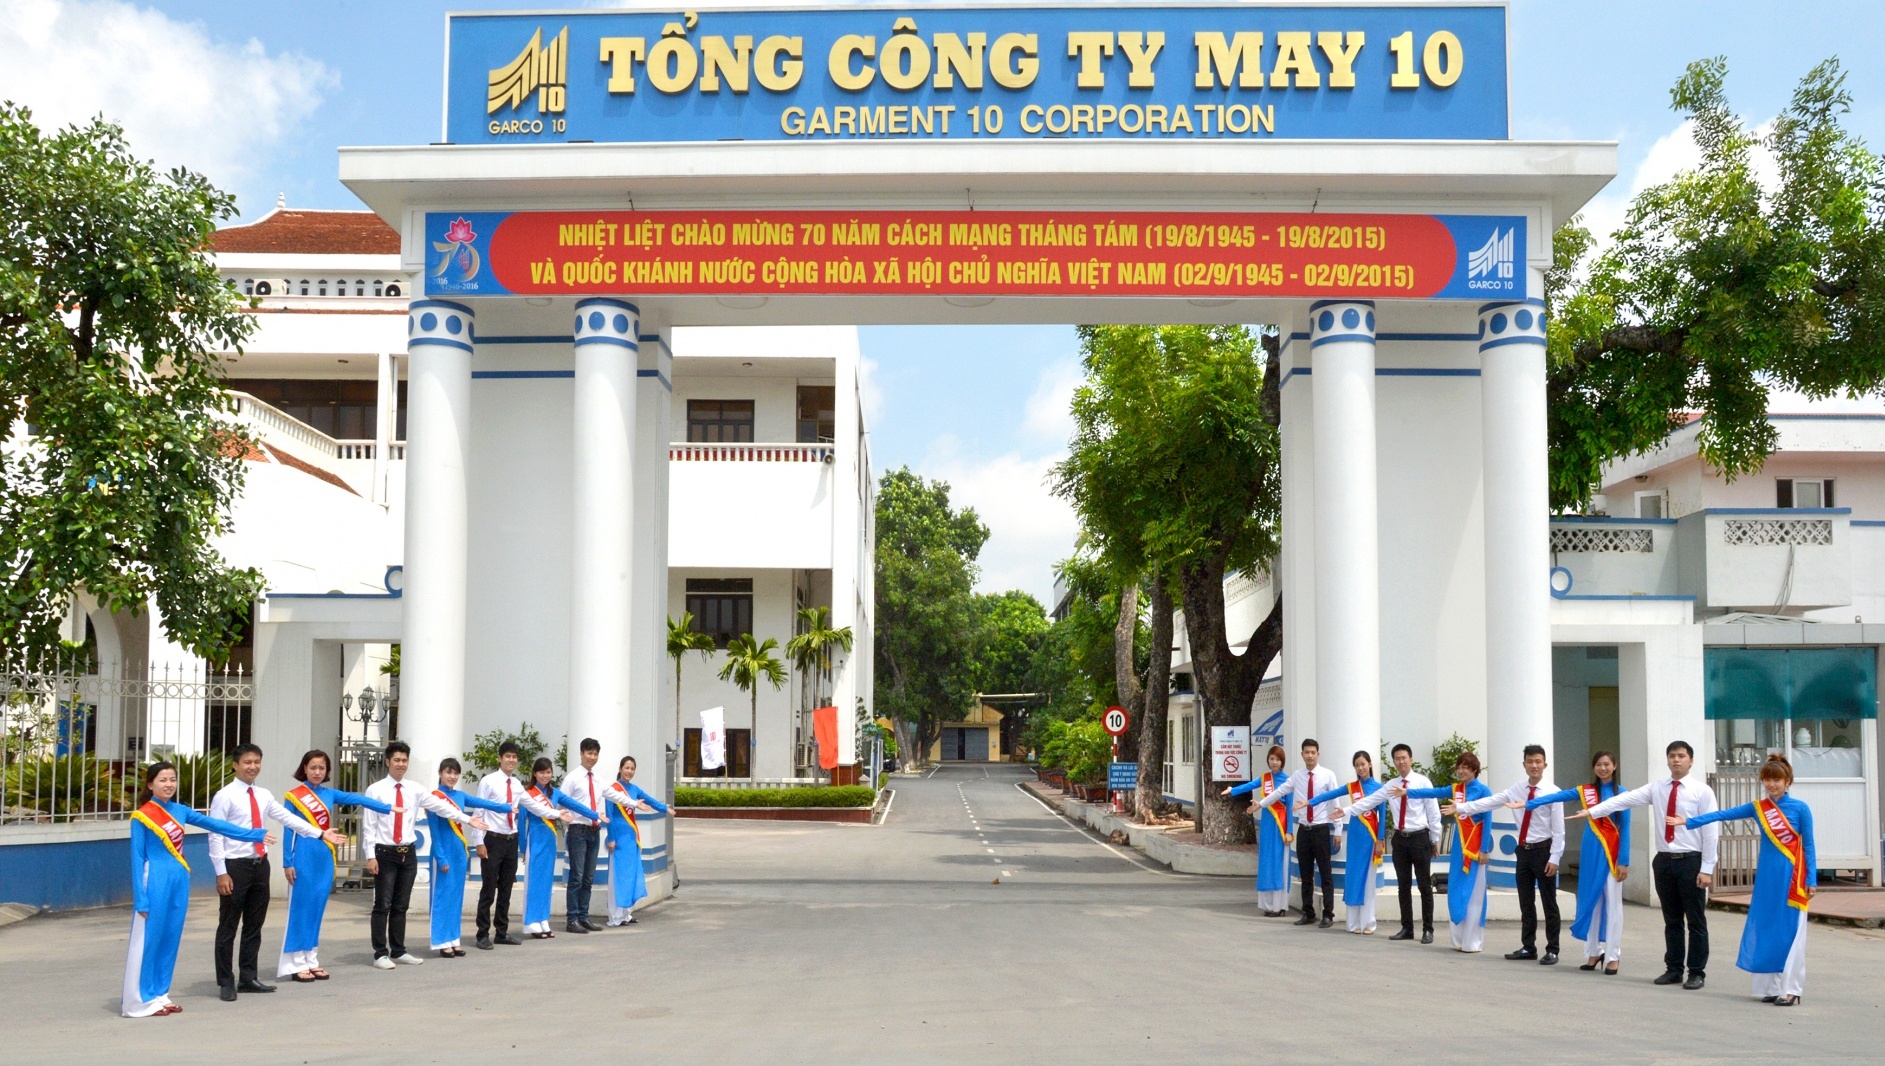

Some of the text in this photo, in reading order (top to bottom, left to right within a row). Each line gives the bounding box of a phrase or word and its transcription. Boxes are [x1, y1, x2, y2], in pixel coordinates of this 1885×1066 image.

[599, 10, 1464, 94] TỔNG CÔNG TY MAY 10
[489, 119, 566, 135] GARCO 10
[781, 104, 1275, 135] GARMENT 10 CORPORATION
[559, 219, 618, 251] NHIỆT
[624, 219, 665, 251] LIỆT
[671, 219, 726, 246] CHÀO
[732, 218, 794, 246] MỪNG
[801, 223, 826, 246] 70
[832, 219, 881, 246] NĂM
[887, 219, 943, 247] CÁCH
[949, 223, 1013, 251] MẠNG
[1018, 219, 1088, 247] THÁNG
[1093, 220, 1139, 247] TÁM
[1145, 224, 1256, 249] (19/8/1945
[1277, 225, 1386, 251] 19/8/2015)
[531, 258, 557, 285] VÀ
[562, 254, 617, 286] QUỐC
[623, 257, 693, 284] KHÁNH
[699, 257, 756, 285] NƯỚC
[762, 257, 819, 289] CỘNG
[825, 256, 867, 285] HÒA
[873, 257, 902, 284] XÃ
[907, 257, 942, 289] HỘI
[949, 254, 991, 285] CHỦ
[997, 257, 1062, 285] NGHĨA
[1067, 258, 1112, 290] VIỆT
[1118, 261, 1167, 286] NAM
[1173, 263, 1285, 288] (02/9/1945
[1304, 263, 1415, 289] 02/9/2015)
[1468, 280, 1514, 290] GARCO 10
[1109, 714, 1122, 728] 10
[300, 793, 329, 826] MAY 10
[1583, 788, 1597, 805] MAY
[161, 820, 184, 843] MAY
[1764, 808, 1794, 844] MAY 10
